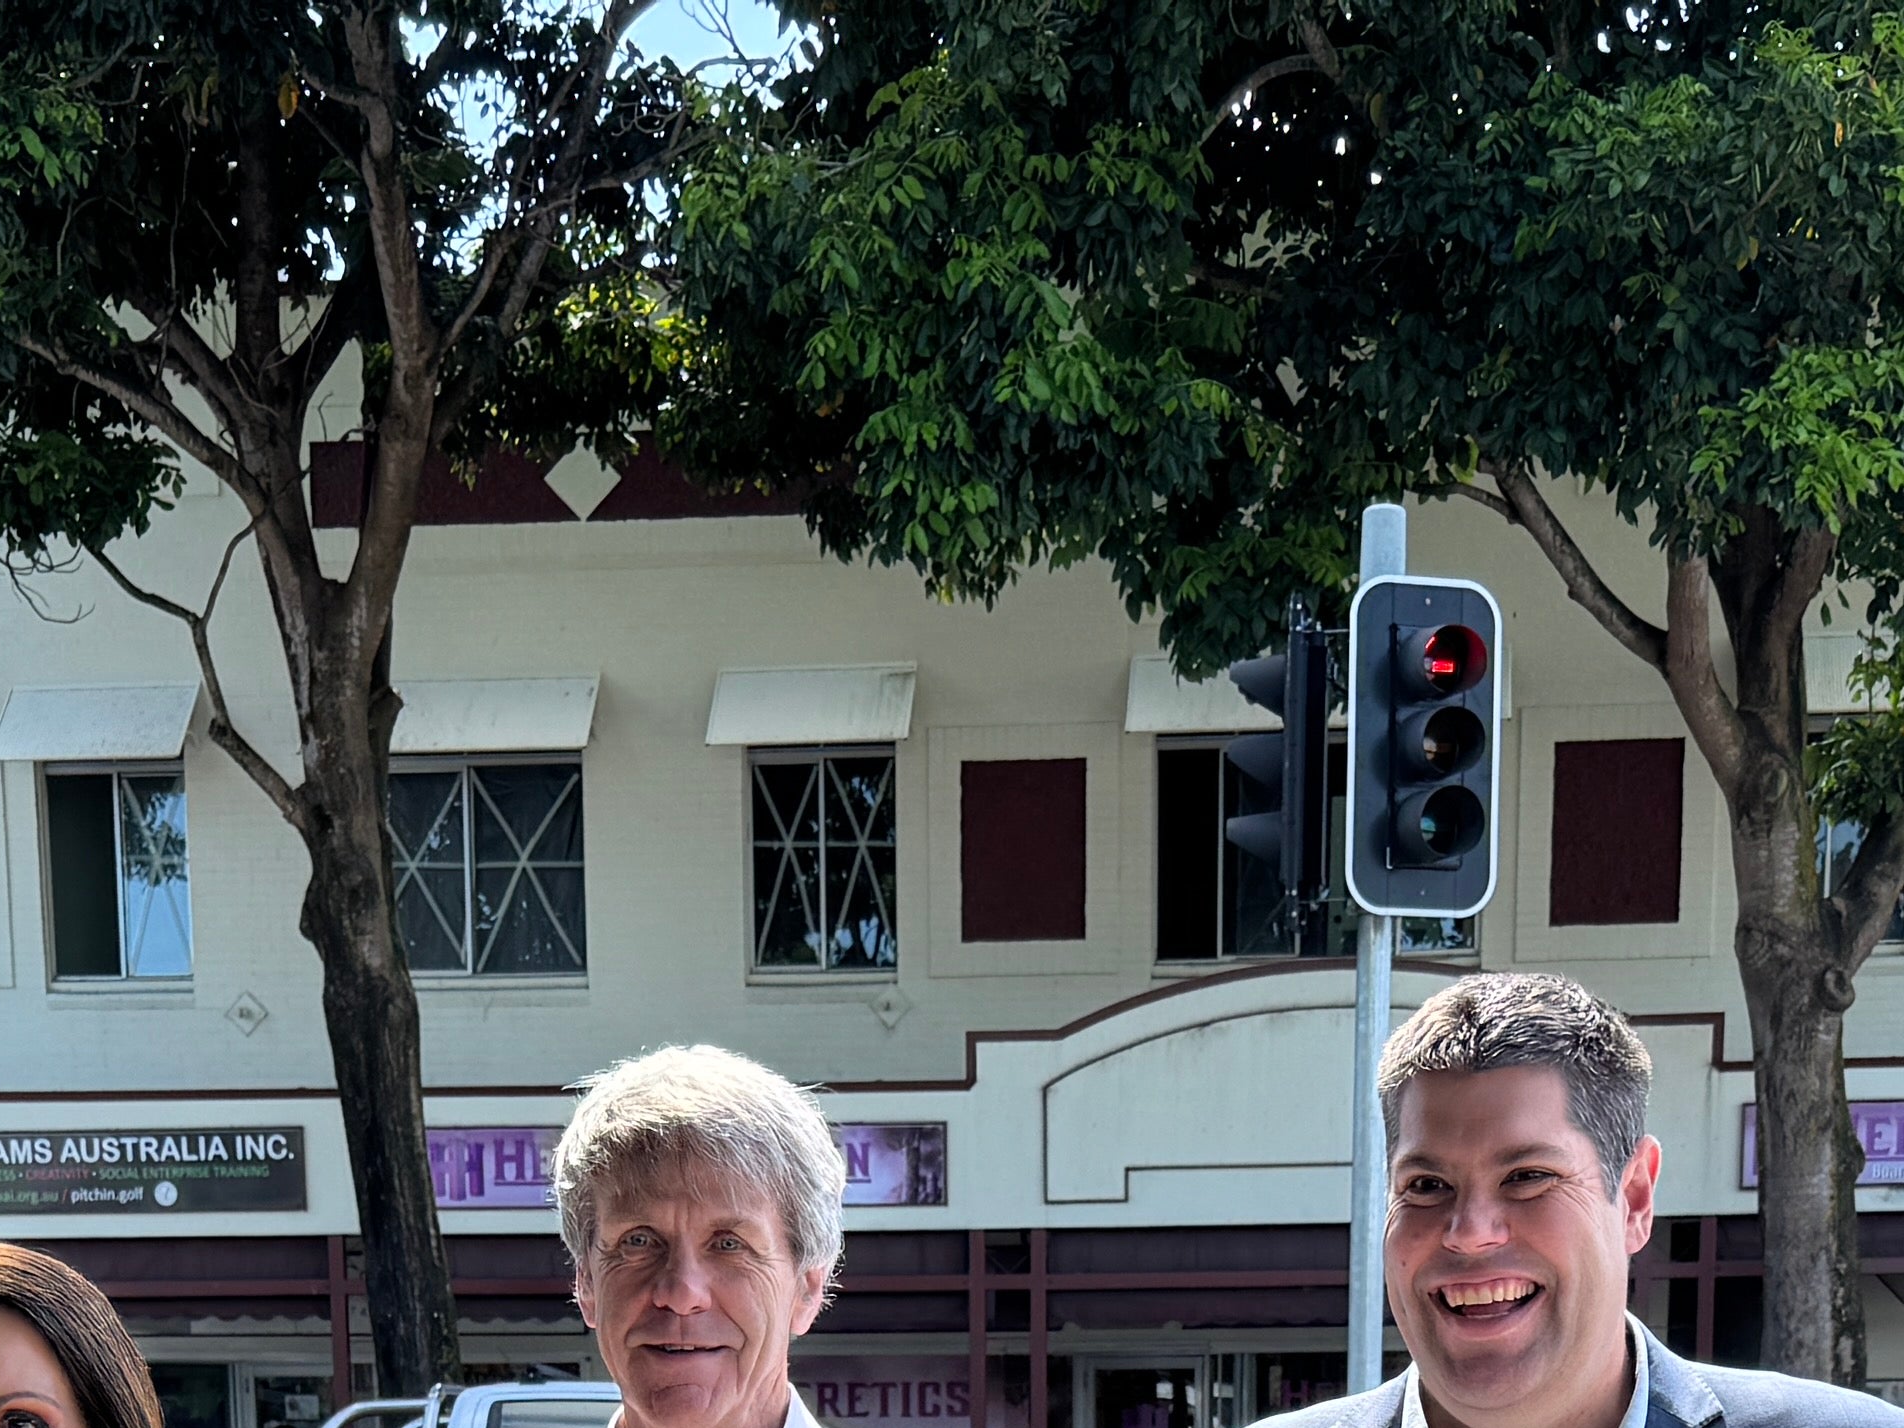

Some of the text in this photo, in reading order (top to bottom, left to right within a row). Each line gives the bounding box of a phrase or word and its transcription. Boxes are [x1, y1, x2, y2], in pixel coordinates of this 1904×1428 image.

[60, 1135, 229, 1164] AUSTRALIA
[235, 1134, 295, 1162] INC.
[99, 1166, 140, 1180] SOCIAL
[143, 1165, 211, 1179] ENTERPRISE
[213, 1164, 270, 1178] TRAINING
[71, 1186, 144, 1204] pitchin.golf
[797, 1381, 971, 1418] RETICS
